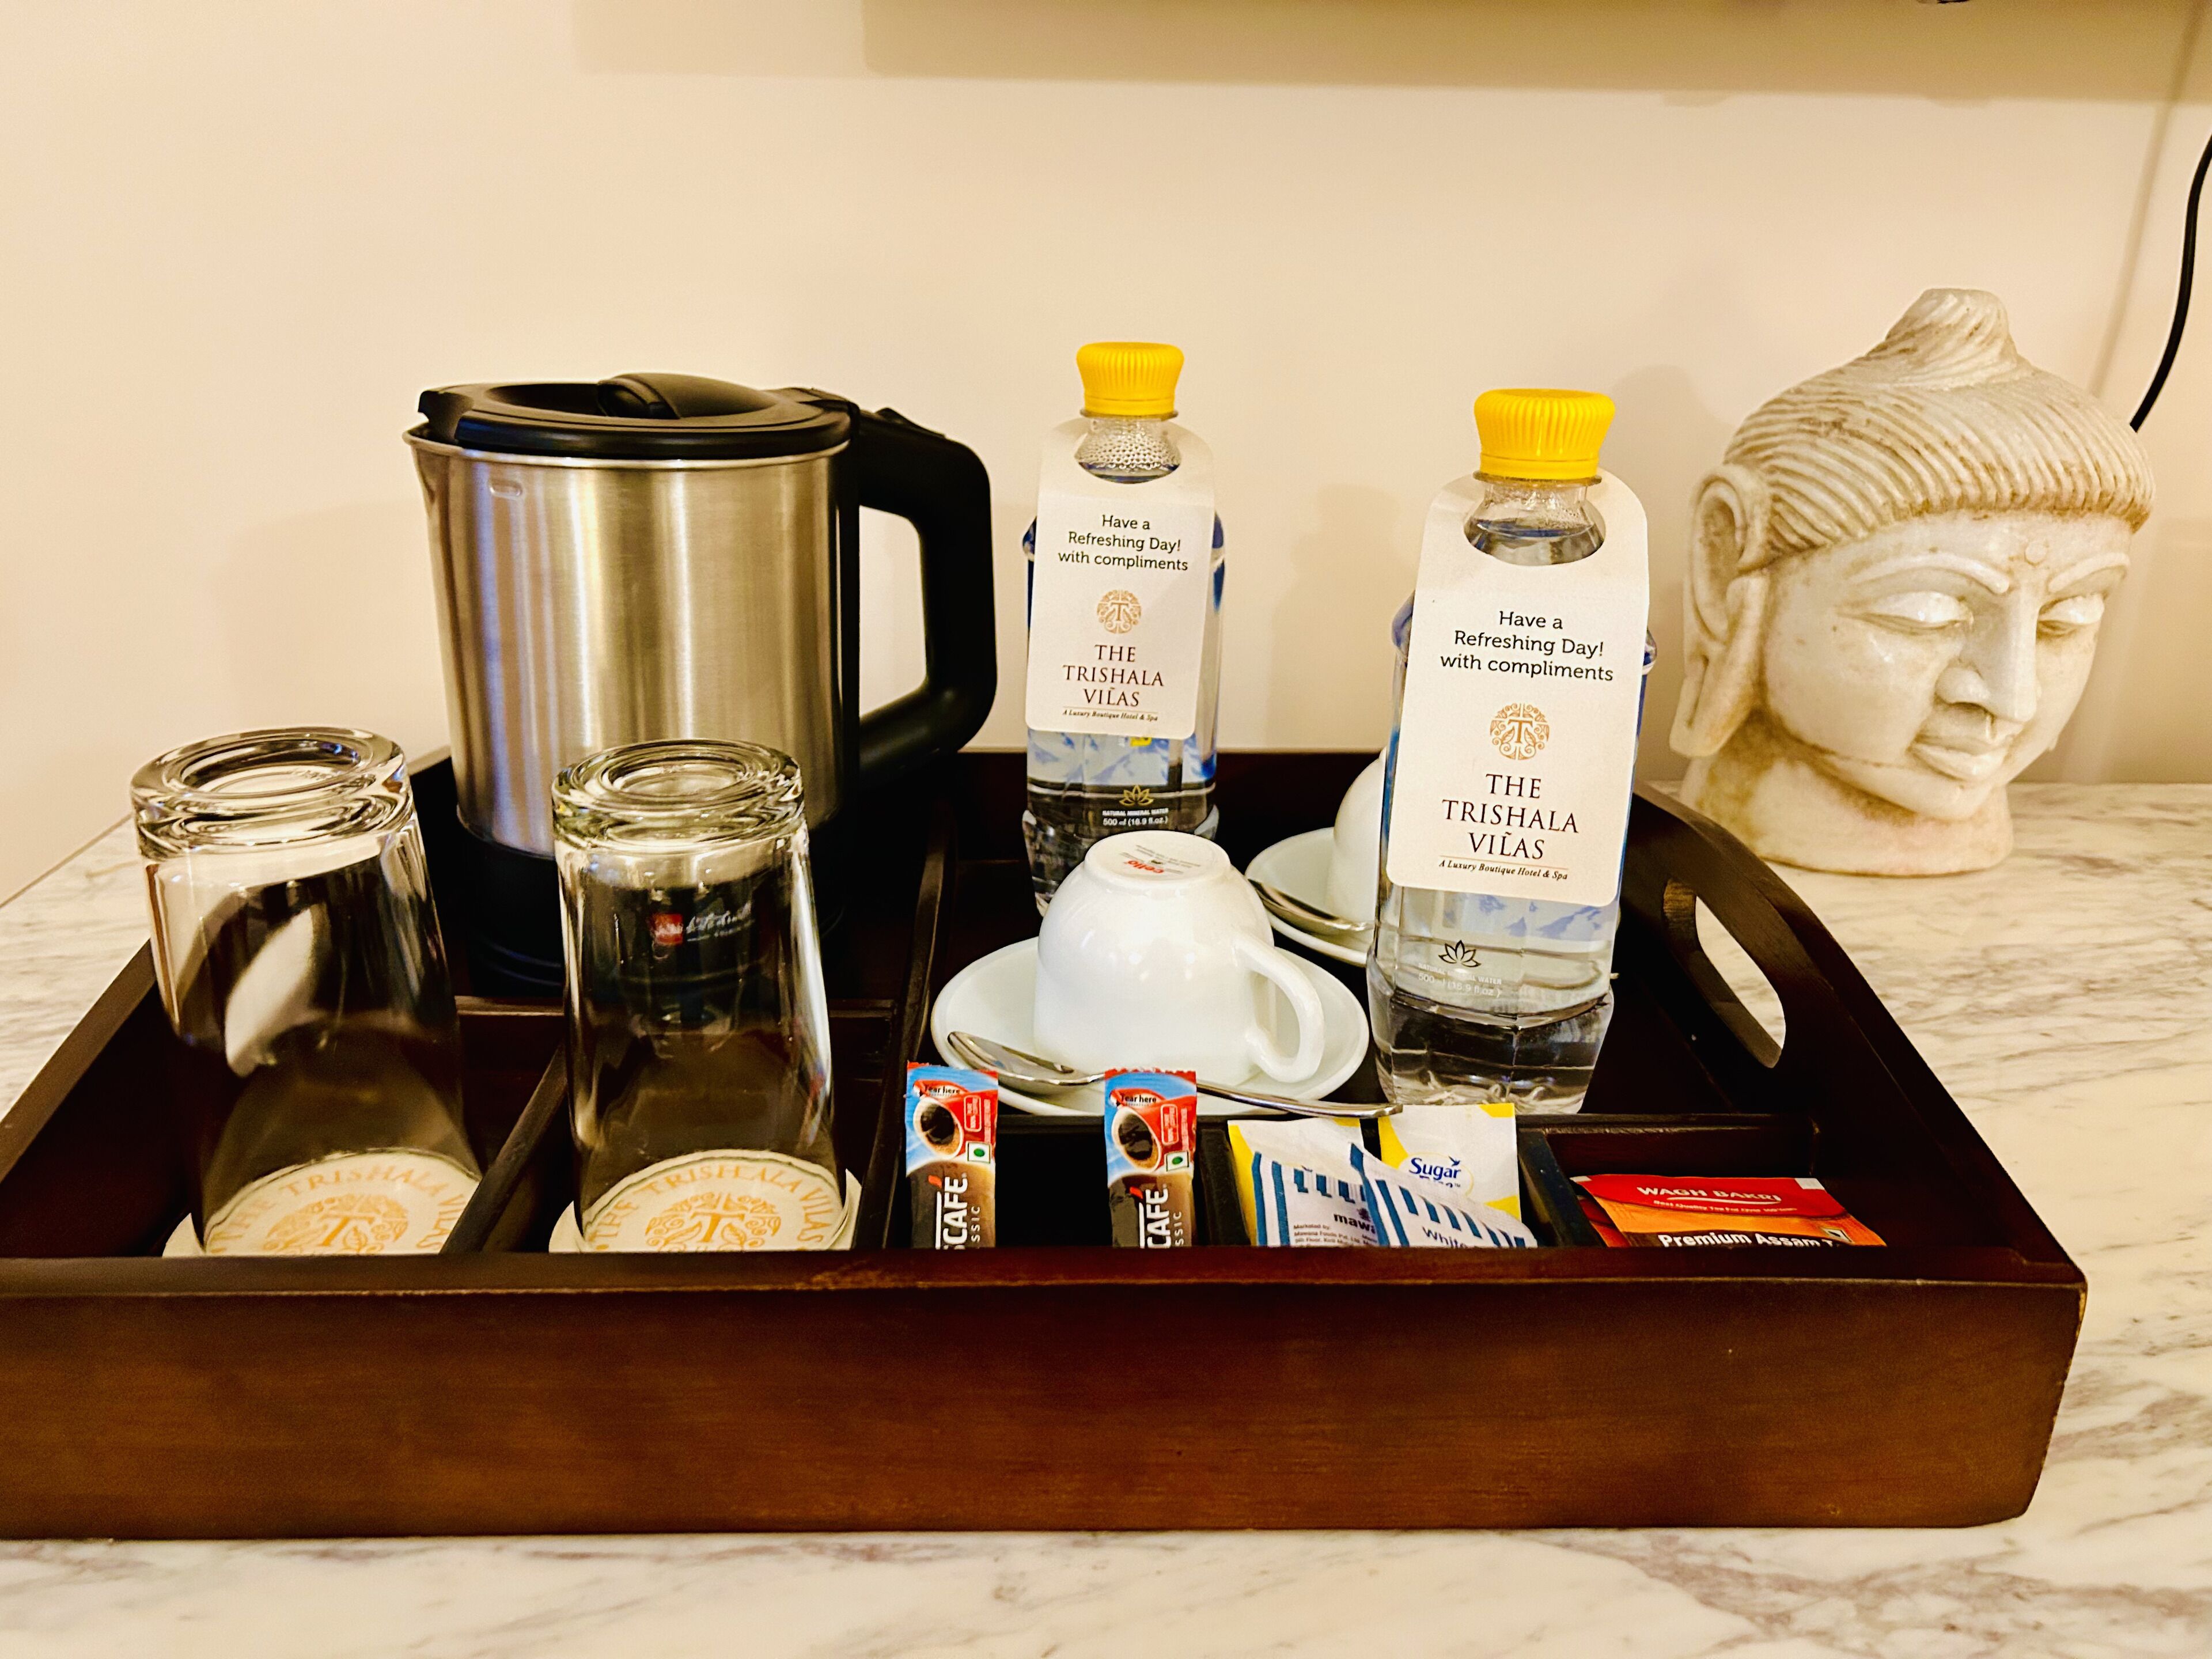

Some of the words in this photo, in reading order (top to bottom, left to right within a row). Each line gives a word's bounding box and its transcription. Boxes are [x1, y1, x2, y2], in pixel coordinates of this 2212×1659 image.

[1101, 514, 1138, 529] Have
[1142, 520, 1150, 530] a
[1068, 531, 1145, 551] Refreshing
[1149, 537, 1181, 554] Day!
[1058, 550, 1090, 563] with
[1094, 554, 1188, 571] compliments
[1498, 611, 1547, 629] Have
[1552, 616, 1563, 630] a
[1094, 645, 1136, 662] THE
[1454, 631, 1555, 656] Refreshing
[1562, 638, 1604, 659] Day!
[1062, 665, 1164, 687] TRISHALA
[1440, 654, 1482, 671] with
[1487, 658, 1614, 681] compliments
[1092, 711, 1119, 719] Boutique
[1485, 774, 1541, 799] THE
[1103, 818, 1118, 826] 500
[1442, 799, 1579, 834] TRISHALA
[1447, 860, 1477, 871] Luxury
[1479, 863, 1516, 875] Boutique
[1517, 867, 1541, 877] Hotel
[1552, 870, 1568, 881] Spa
[1418, 972, 1435, 983] 500
[942, 1085, 960, 1094] here
[1139, 1094, 1157, 1103] here
[1408, 1157, 1461, 1181] Sugar
[279, 1165, 448, 1198] TRISHALA
[589, 1198, 639, 1243] THE
[637, 1162, 805, 1195] TRISHALA
[797, 1186, 835, 1244] VILAS
[1637, 1187, 1707, 1196] WAGH
[1713, 1190, 1782, 1202] BAKRI
[1657, 1232, 1752, 1248] Premium
[1755, 1233, 1820, 1247] Assam
